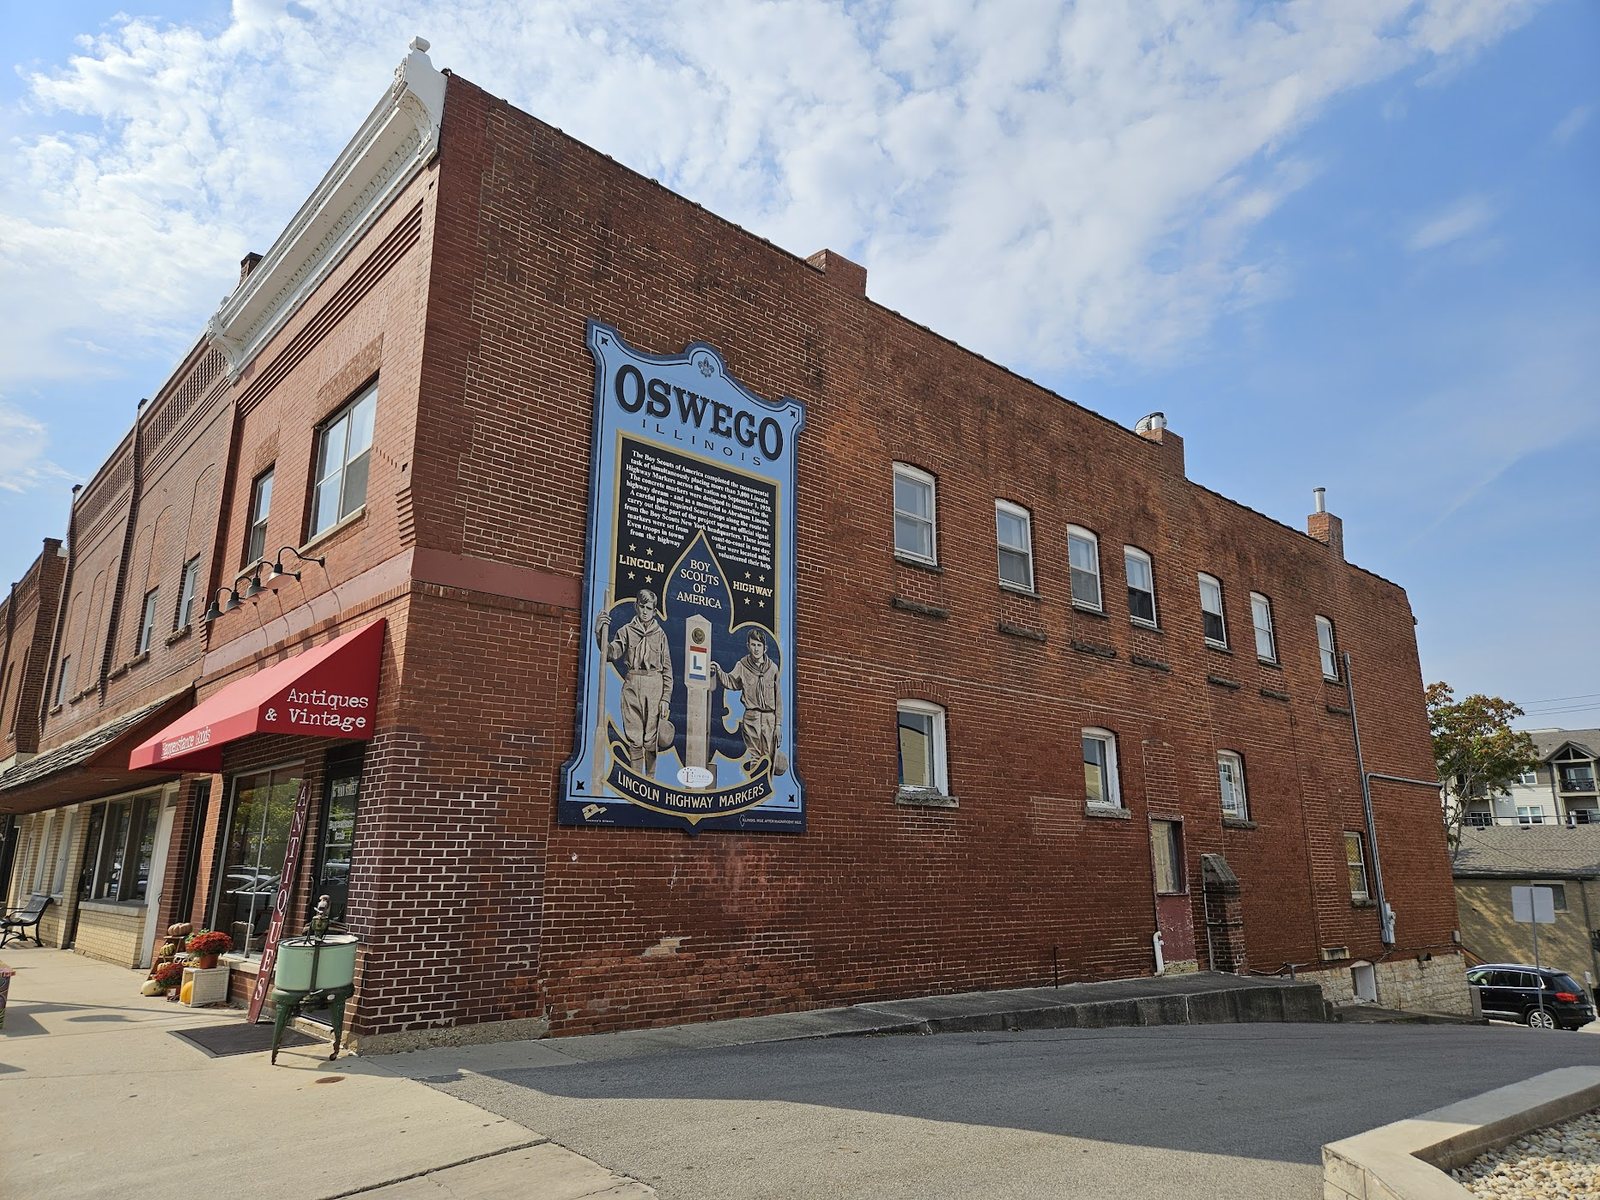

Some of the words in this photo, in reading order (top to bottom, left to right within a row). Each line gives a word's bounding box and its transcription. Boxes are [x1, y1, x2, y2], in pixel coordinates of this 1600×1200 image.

[615, 364, 783, 461] OSWEGO
[642, 419, 761, 466] ILLINOIS
[633, 450, 643, 458] The
[645, 454, 655, 463] Boy
[657, 458, 674, 468] Scouts
[682, 466, 703, 477] America
[705, 474, 730, 485] completed
[651, 464, 690, 482] simultaneously
[691, 477, 710, 488] placing
[751, 494, 768, 504] Lincoln
[626, 464, 651, 477] Highway
[652, 472, 676, 484] Markers
[677, 481, 693, 489] across
[704, 489, 719, 497] nation
[728, 495, 753, 506] September
[626, 480, 650, 493] highway
[651, 488, 669, 497] dream
[727, 510, 750, 520] Abraham
[629, 473, 640, 481] The
[642, 478, 665, 488] concrete
[666, 485, 688, 495] markers
[703, 495, 724, 506] designed
[624, 503, 638, 512] from
[650, 510, 661, 519] Boy
[662, 513, 679, 523] Scouts
[743, 535, 756, 544] These
[628, 498, 643, 506] carry
[698, 517, 716, 525] project
[755, 532, 769, 540] signal
[636, 492, 655, 501] careful
[670, 502, 692, 512] required
[694, 507, 708, 516] Scout
[709, 512, 725, 521] troops
[726, 517, 739, 526] along
[627, 513, 651, 523] markers
[676, 525, 688, 533] from
[712, 536, 745, 548] coast-to-coast
[627, 520, 641, 529] Even
[643, 525, 660, 534] troops
[668, 531, 684, 540] towns
[740, 549, 757, 558] located
[630, 529, 644, 537] from
[658, 536, 680, 548] highway
[619, 555, 665, 573] LINCOLN
[681, 568, 719, 586] SCOUTS
[690, 560, 711, 572] BOY
[677, 593, 722, 609] AMERICA
[693, 583, 707, 594] OF
[733, 580, 773, 598] HIGHWAY
[694, 656, 702, 670] L
[287, 688, 368, 711] Antiques
[266, 708, 278, 721] &
[290, 708, 366, 731] Vintage
[618, 771, 660, 802] LINCOLN
[665, 792, 714, 809] HIGHWAY
[719, 783, 765, 806] MARKERS
[254, 786, 306, 1001] ANTIQUES
